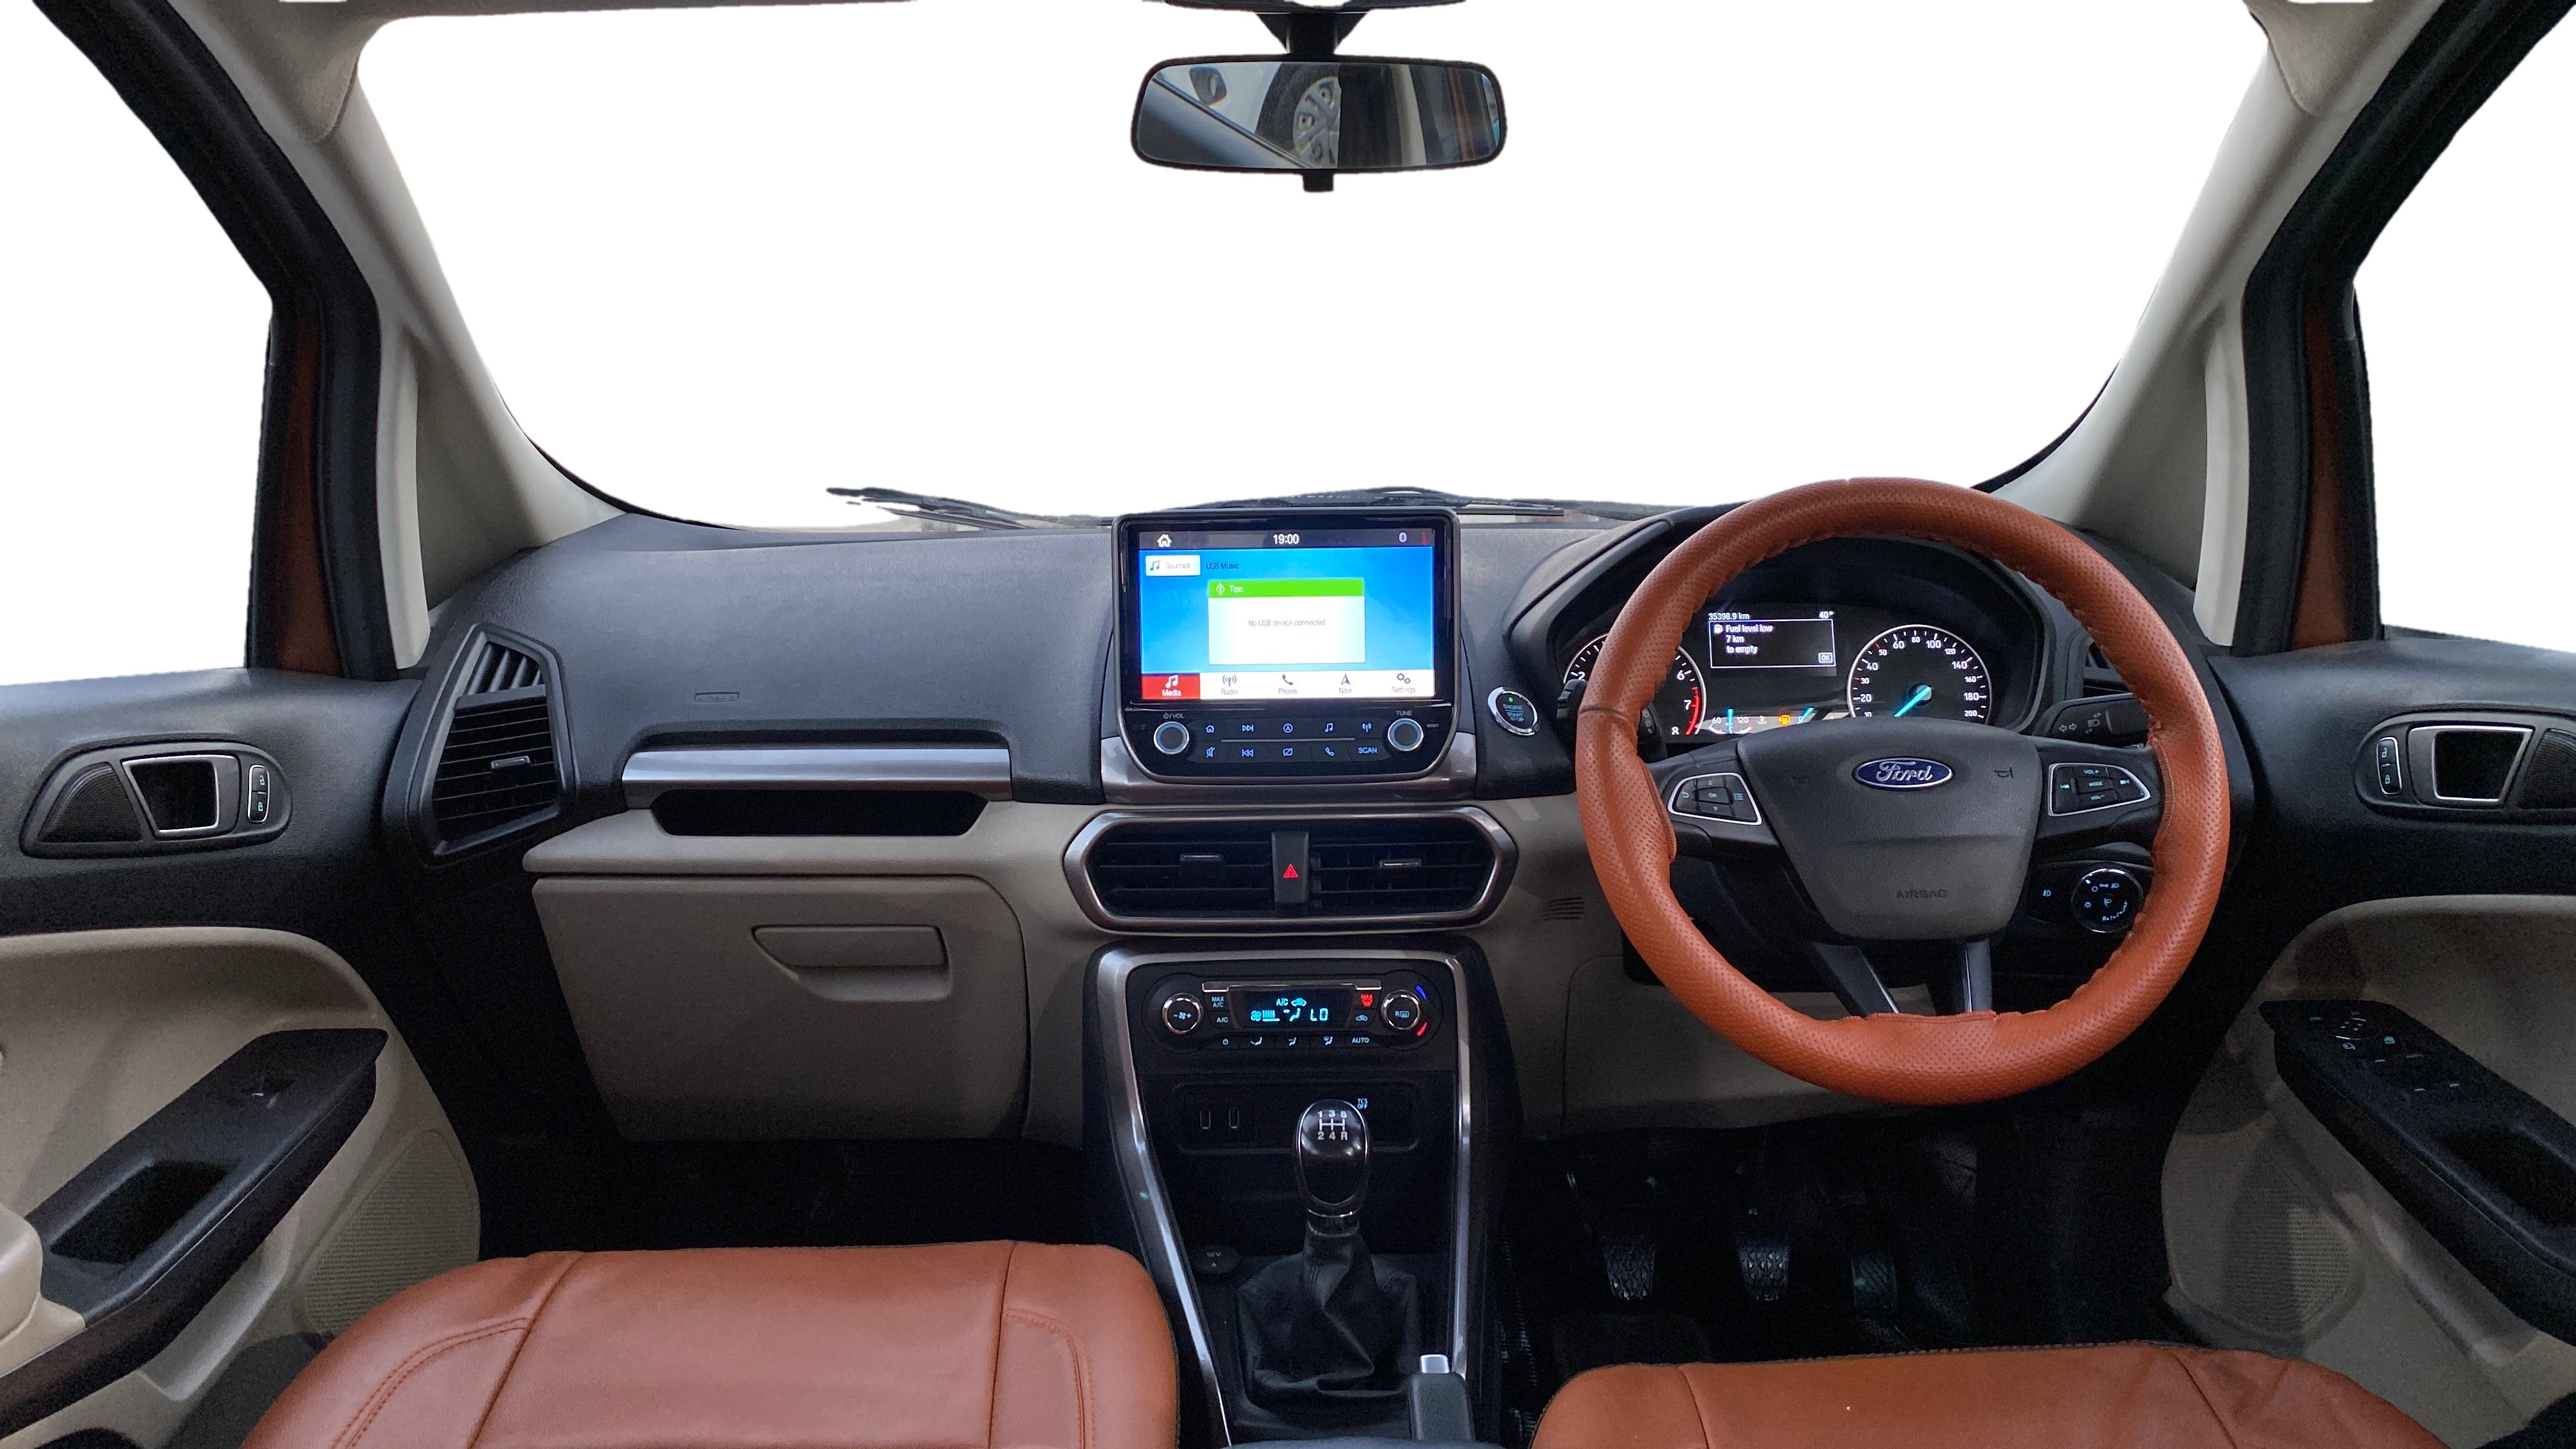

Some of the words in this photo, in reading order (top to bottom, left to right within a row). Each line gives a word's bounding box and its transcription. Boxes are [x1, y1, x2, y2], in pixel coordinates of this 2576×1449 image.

[1273, 533, 1300, 544] 19:00
[1165, 562, 1190, 570] Sources
[1229, 585, 1245, 593] Tips:
[1726, 624, 1741, 632] Fuel
[1742, 624, 1758, 632] level
[1759, 624, 1773, 632] low
[1732, 634, 1744, 643] km
[1892, 640, 1905, 649] 60
[1925, 640, 1941, 649] 100
[1726, 645, 1734, 654] to
[1735, 646, 1758, 654] empty
[1821, 654, 1831, 662] OK
[1866, 662, 1878, 671] 40
[1952, 661, 1968, 670] 140
[1577, 671, 1586, 681] 2
[1677, 670, 1685, 680] 6
[1162, 689, 1181, 697] Media
[1392, 686, 1416, 694] Settings
[1860, 693, 1872, 703] 20
[1963, 692, 1979, 702] 180
[1683, 699, 1692, 710] 7
[1712, 716, 1722, 724] 60
[1876, 761, 1933, 782] Ford
[1895, 889, 1947, 899] AIRBAG
[1276, 998, 1288, 1006] A/C
[1317, 1131, 1324, 1140] 2
[1329, 1131, 1336, 1140] 4
[1341, 1131, 1347, 1140] R
